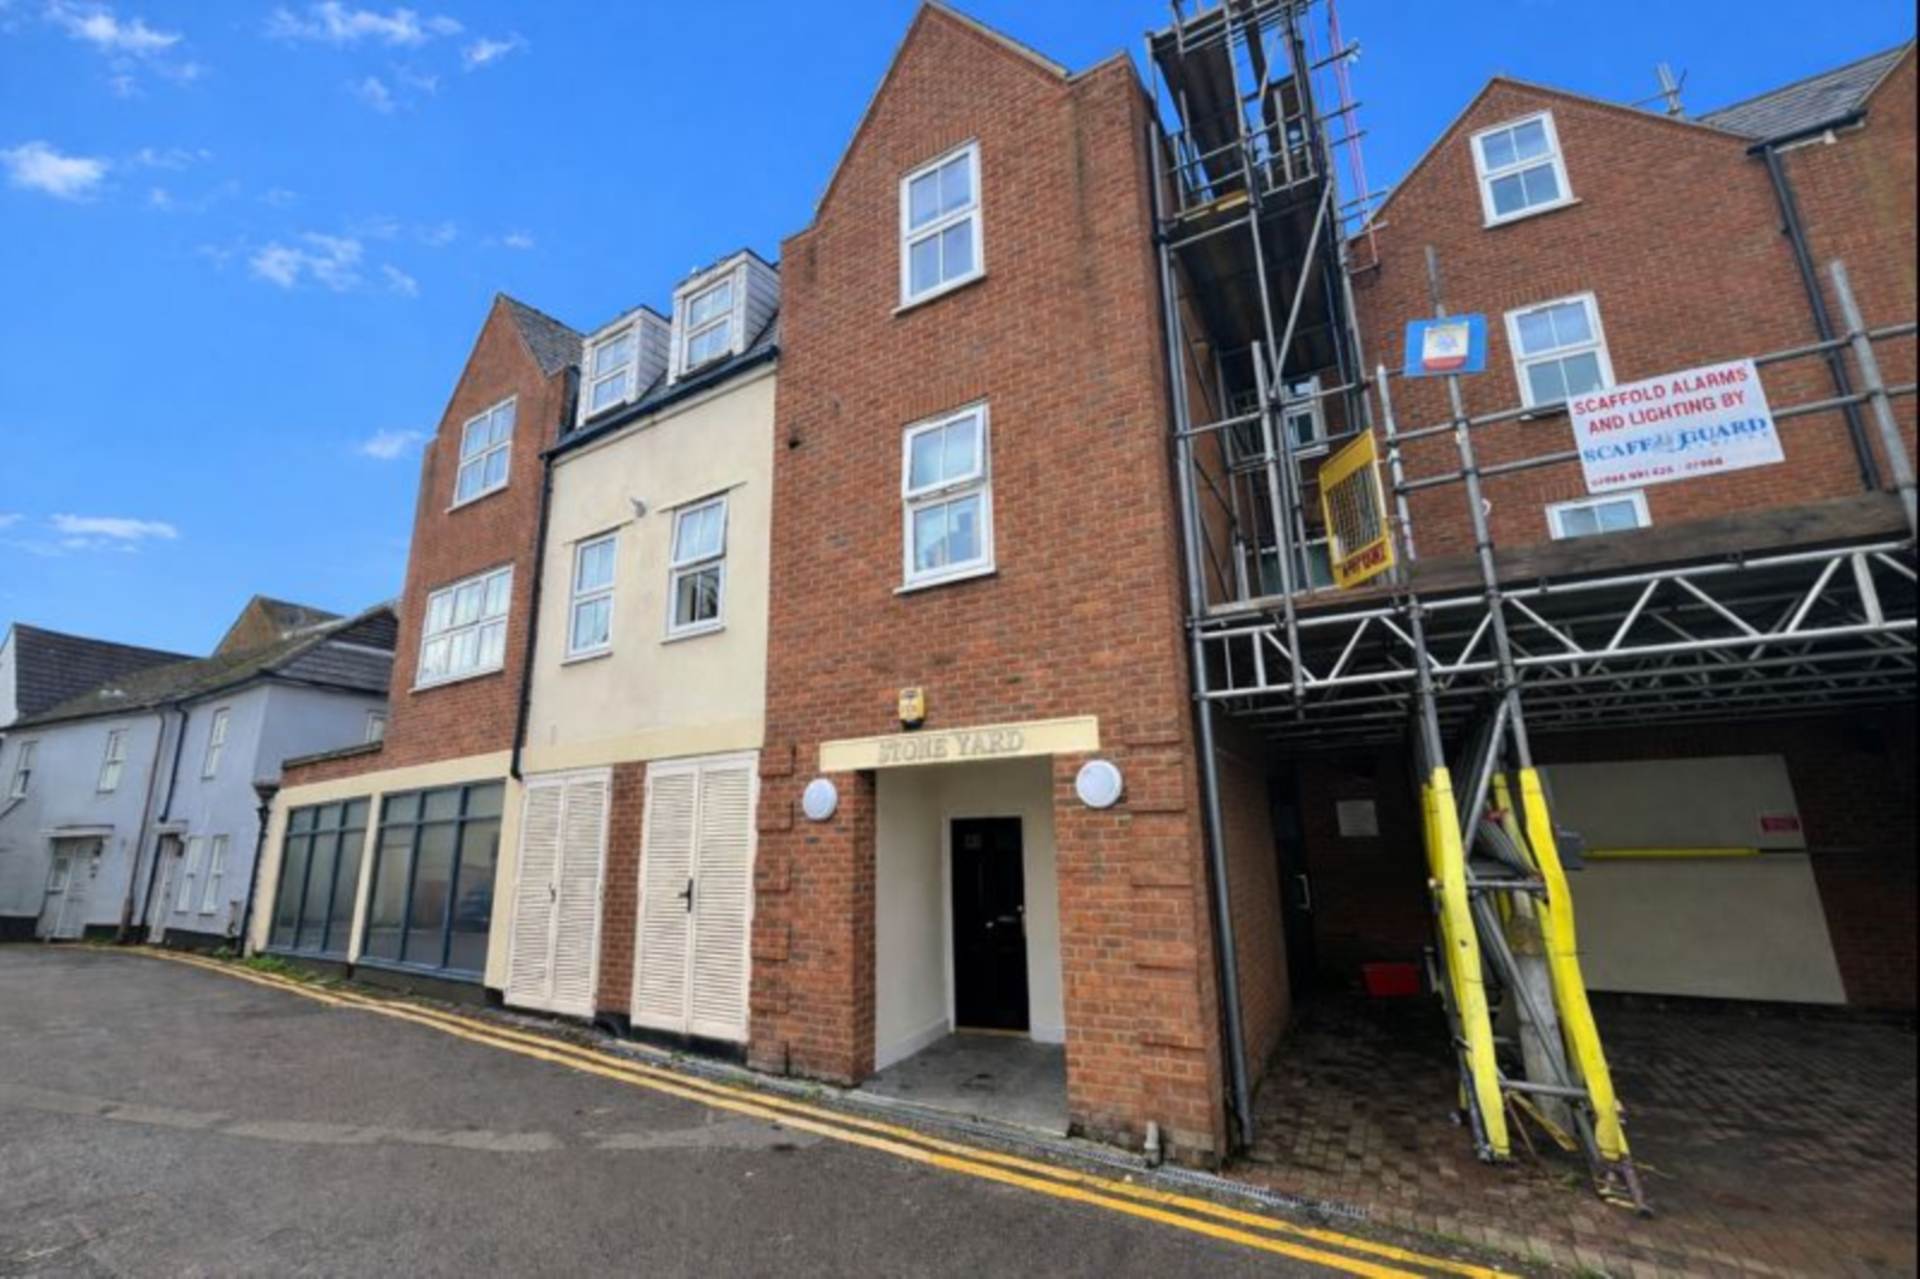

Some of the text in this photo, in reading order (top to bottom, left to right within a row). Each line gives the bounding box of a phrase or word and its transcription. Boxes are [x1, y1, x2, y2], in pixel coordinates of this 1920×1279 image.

[1574, 366, 1749, 416] SCAFFOLD ALARMS
[1589, 390, 1746, 434] AND LIGHTING BY
[956, 729, 1025, 756] YARD
